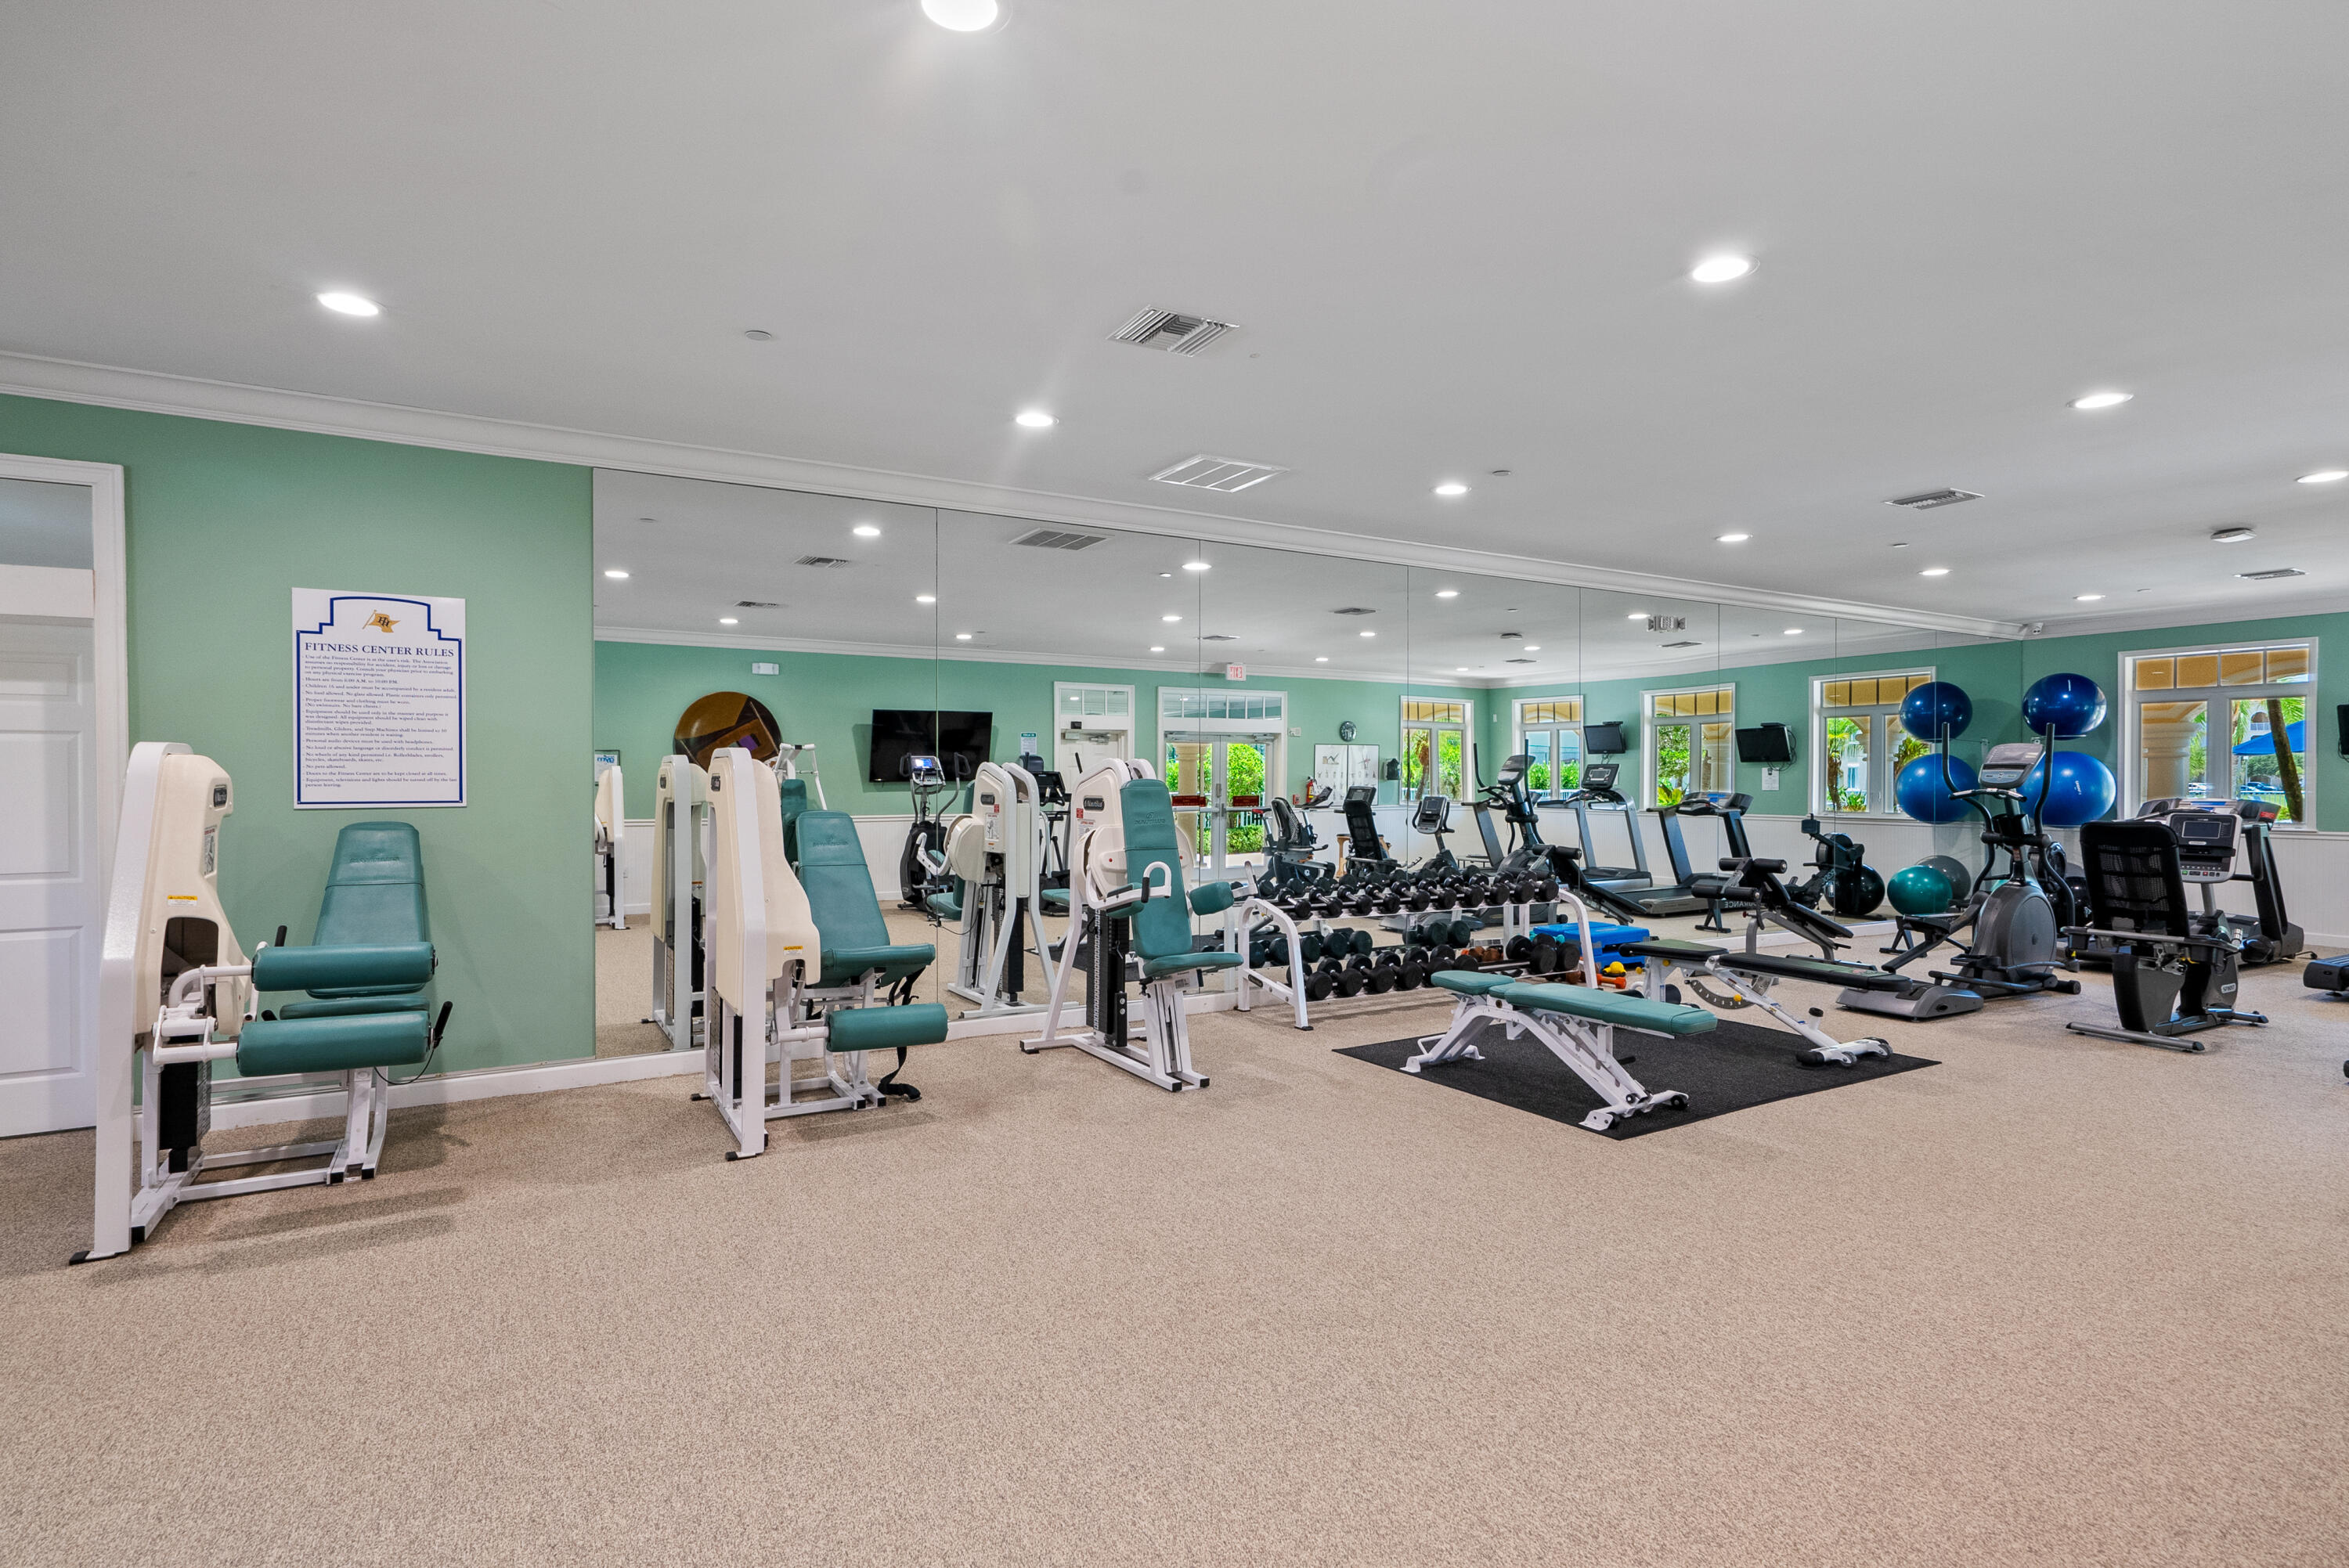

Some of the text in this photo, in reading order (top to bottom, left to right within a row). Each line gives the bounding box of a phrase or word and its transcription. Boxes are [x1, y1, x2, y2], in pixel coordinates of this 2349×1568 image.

[305, 642, 454, 657] FITNESS CENTER RULES
